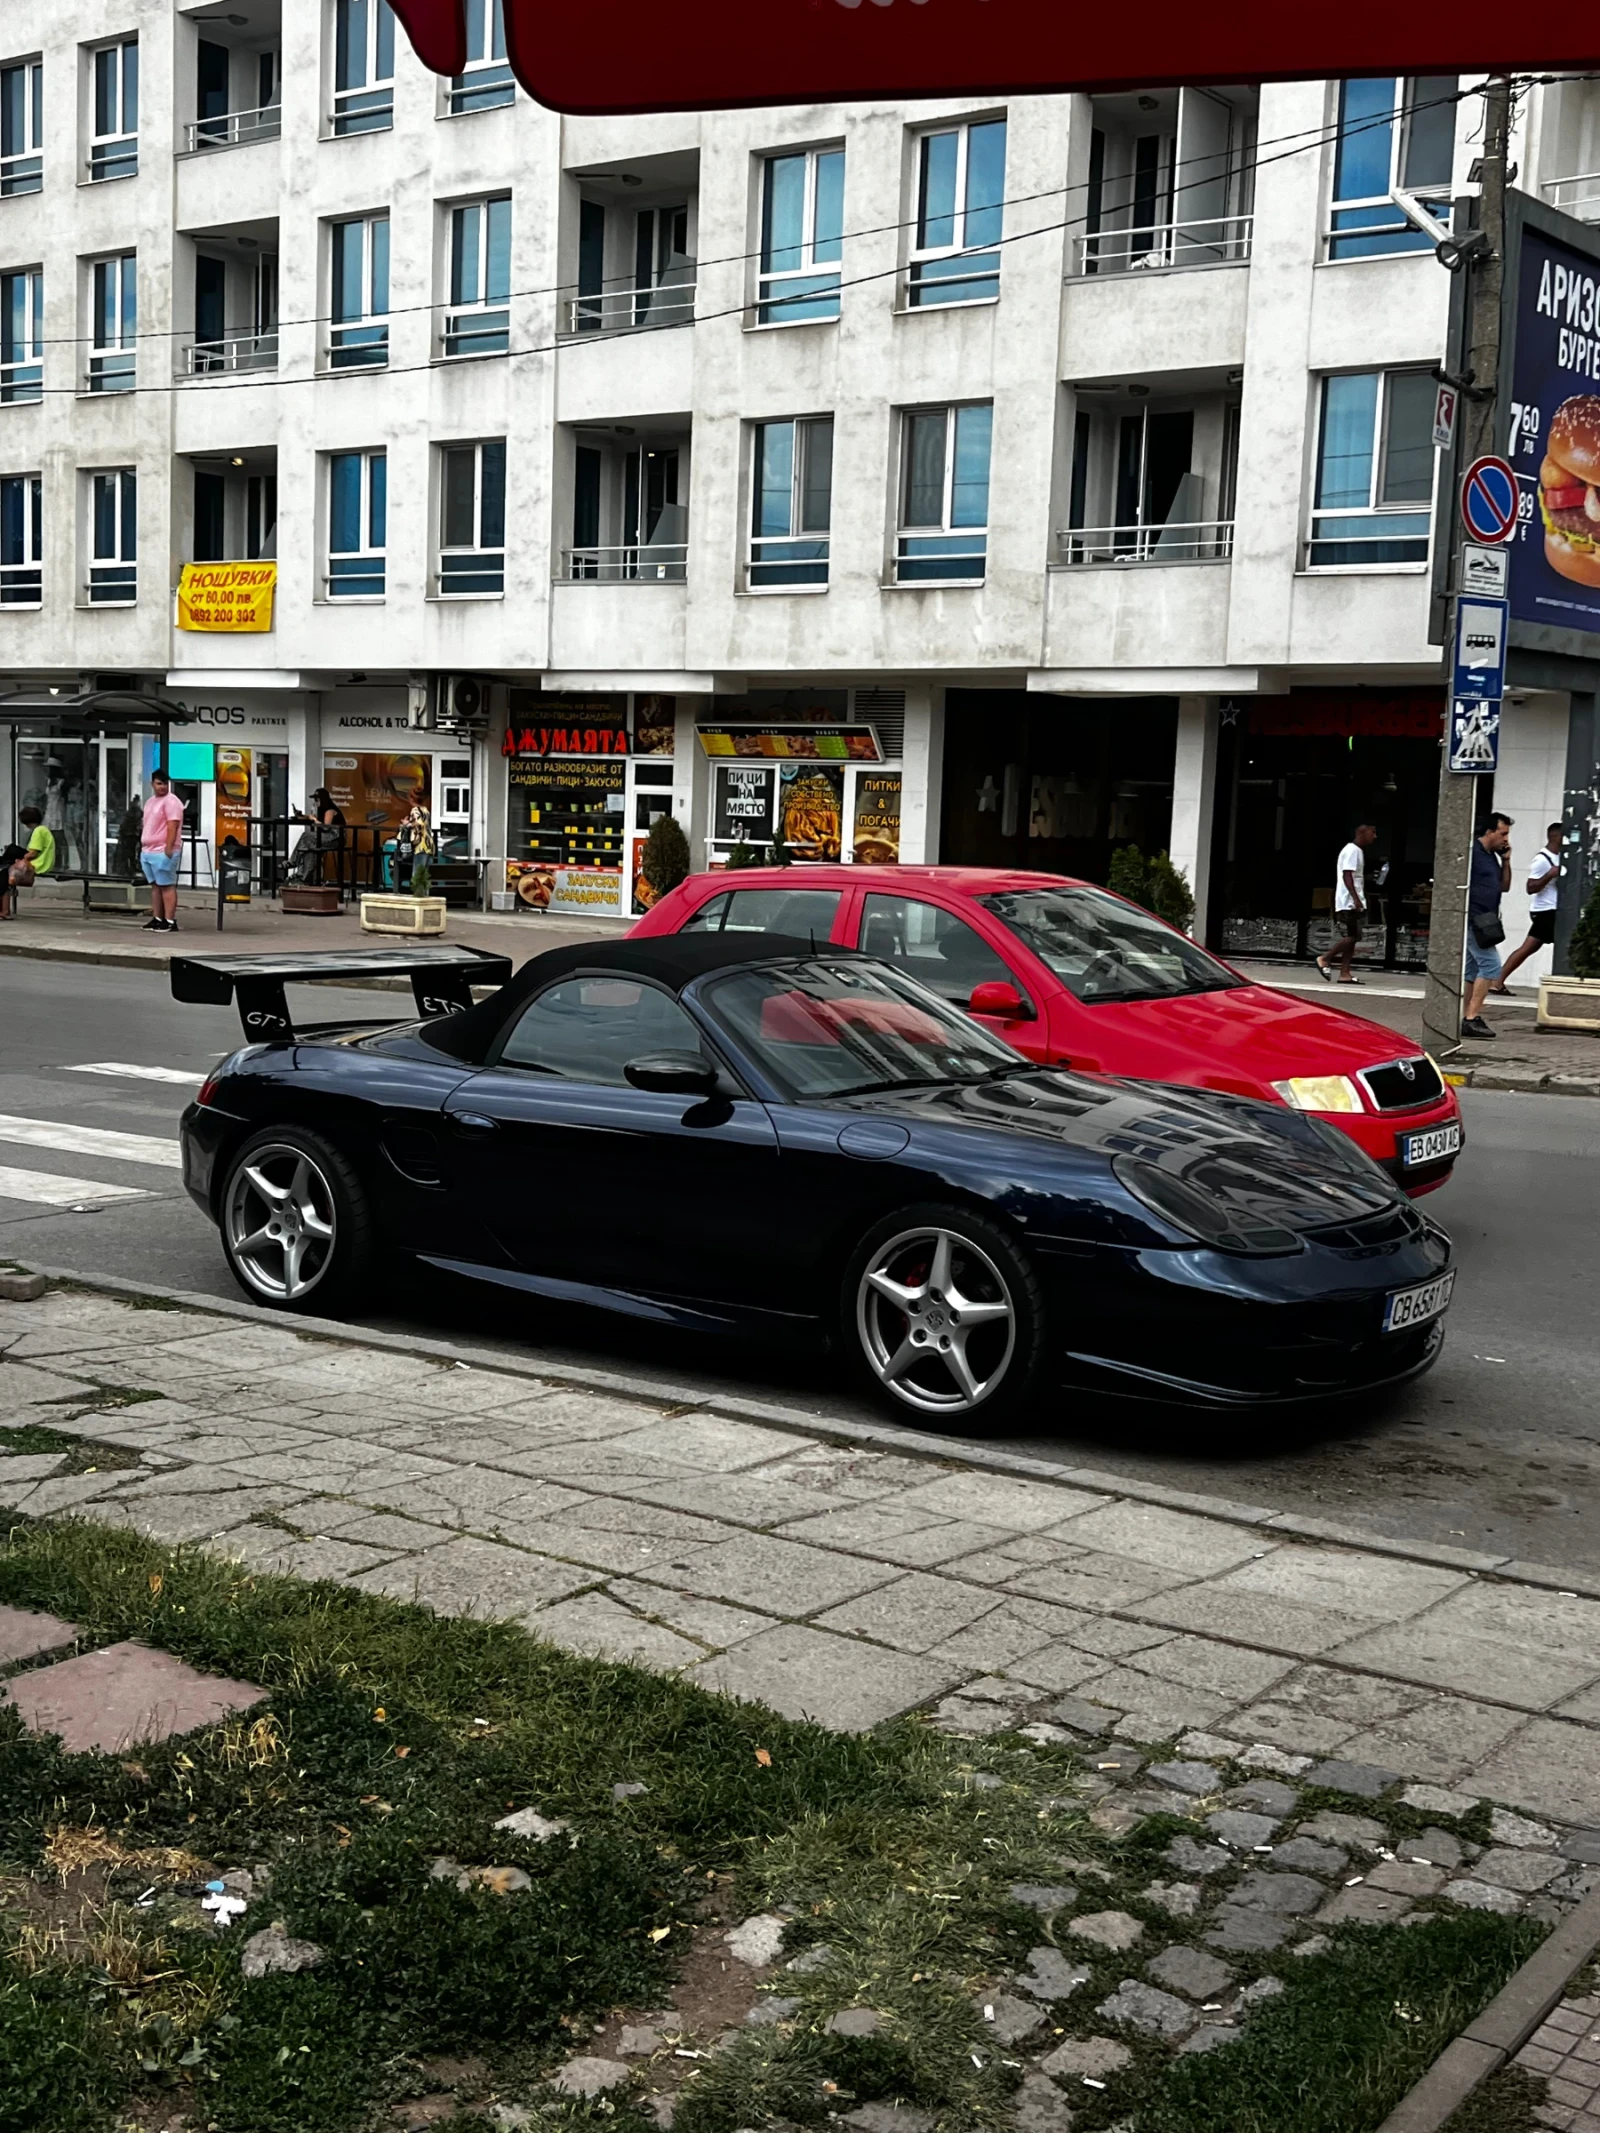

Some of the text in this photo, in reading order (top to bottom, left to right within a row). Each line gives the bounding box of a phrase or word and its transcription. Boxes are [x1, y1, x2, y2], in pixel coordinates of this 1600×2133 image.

[189, 569, 274, 588] НОШУВКИ
[191, 591, 254, 606] от 60,00 лв.
[214, 608, 233, 622] 200
[236, 609, 256, 622] 302
[338, 716, 384, 728] ALCOHOL
[386, 717, 393, 728] &
[502, 727, 627, 757] ДЖУМАЯТА
[510, 761, 623, 775] БОГАТО РАЗНООБРАЗИЕ ОТ
[510, 774, 623, 788] САНДВИЧИ ПИЦИ ЗАКУСКИ
[797, 778, 829, 787] ЗАКУСКИ
[864, 780, 901, 792] ПИТКИ
[739, 788, 755, 799] НА
[790, 789, 834, 799] СОБСТВЕНО
[727, 803, 765, 816] МЯСТО
[783, 801, 841, 812] ПРОИЗВОДСТВО
[877, 798, 886, 809] &
[567, 873, 620, 889] ЗАКУСКИ
[555, 888, 619, 905] САНДВИЧИ
[1410, 1138, 1424, 1161] EB
[1392, 1294, 1412, 1326] CB
